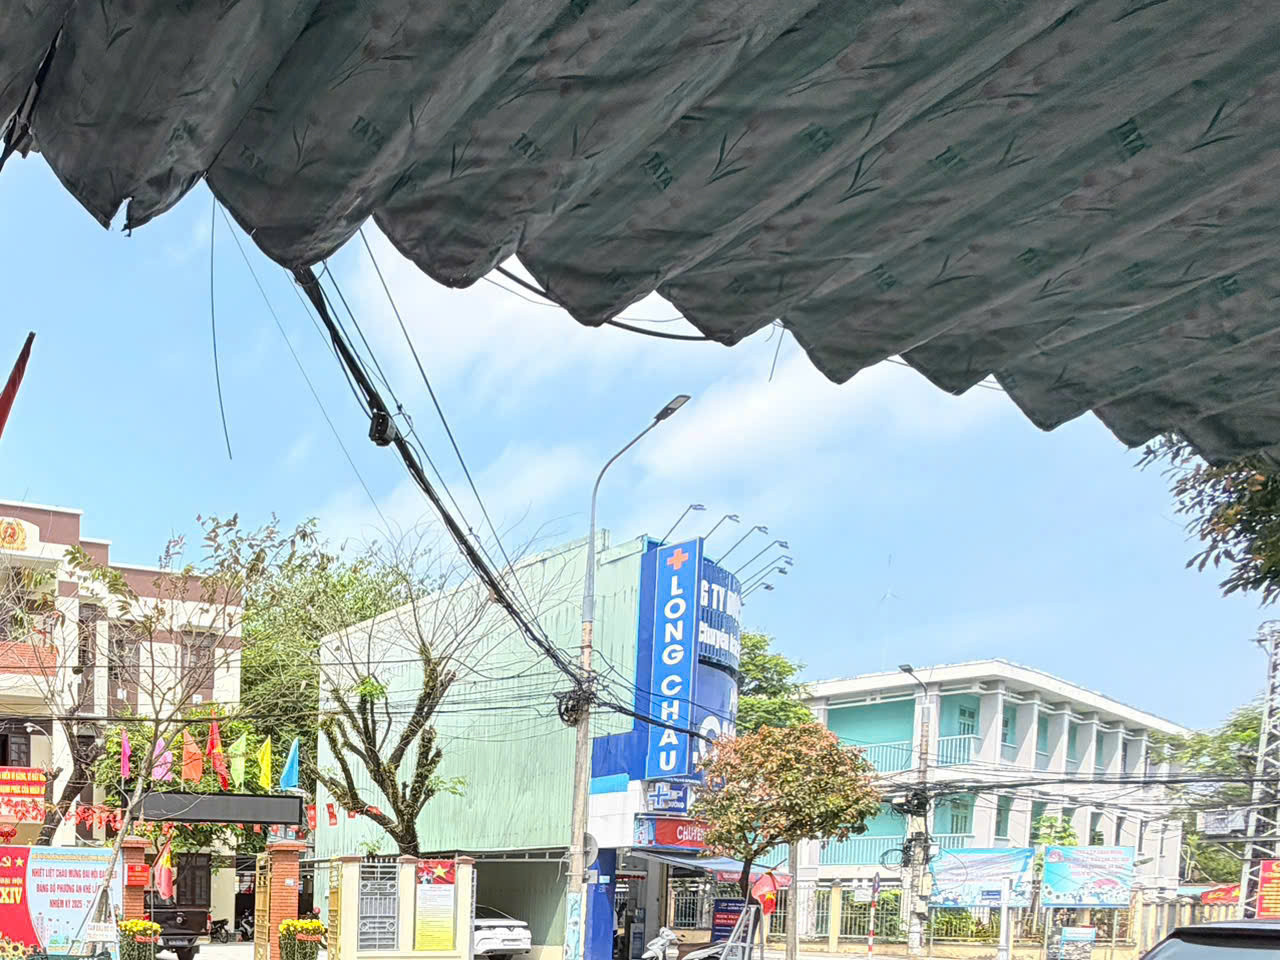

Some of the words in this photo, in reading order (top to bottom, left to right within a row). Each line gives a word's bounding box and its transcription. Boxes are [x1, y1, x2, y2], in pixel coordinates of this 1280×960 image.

[661, 575, 687, 665] LONG
[659, 674, 683, 771] CHÂU
[0, 886, 23, 905] XIV
